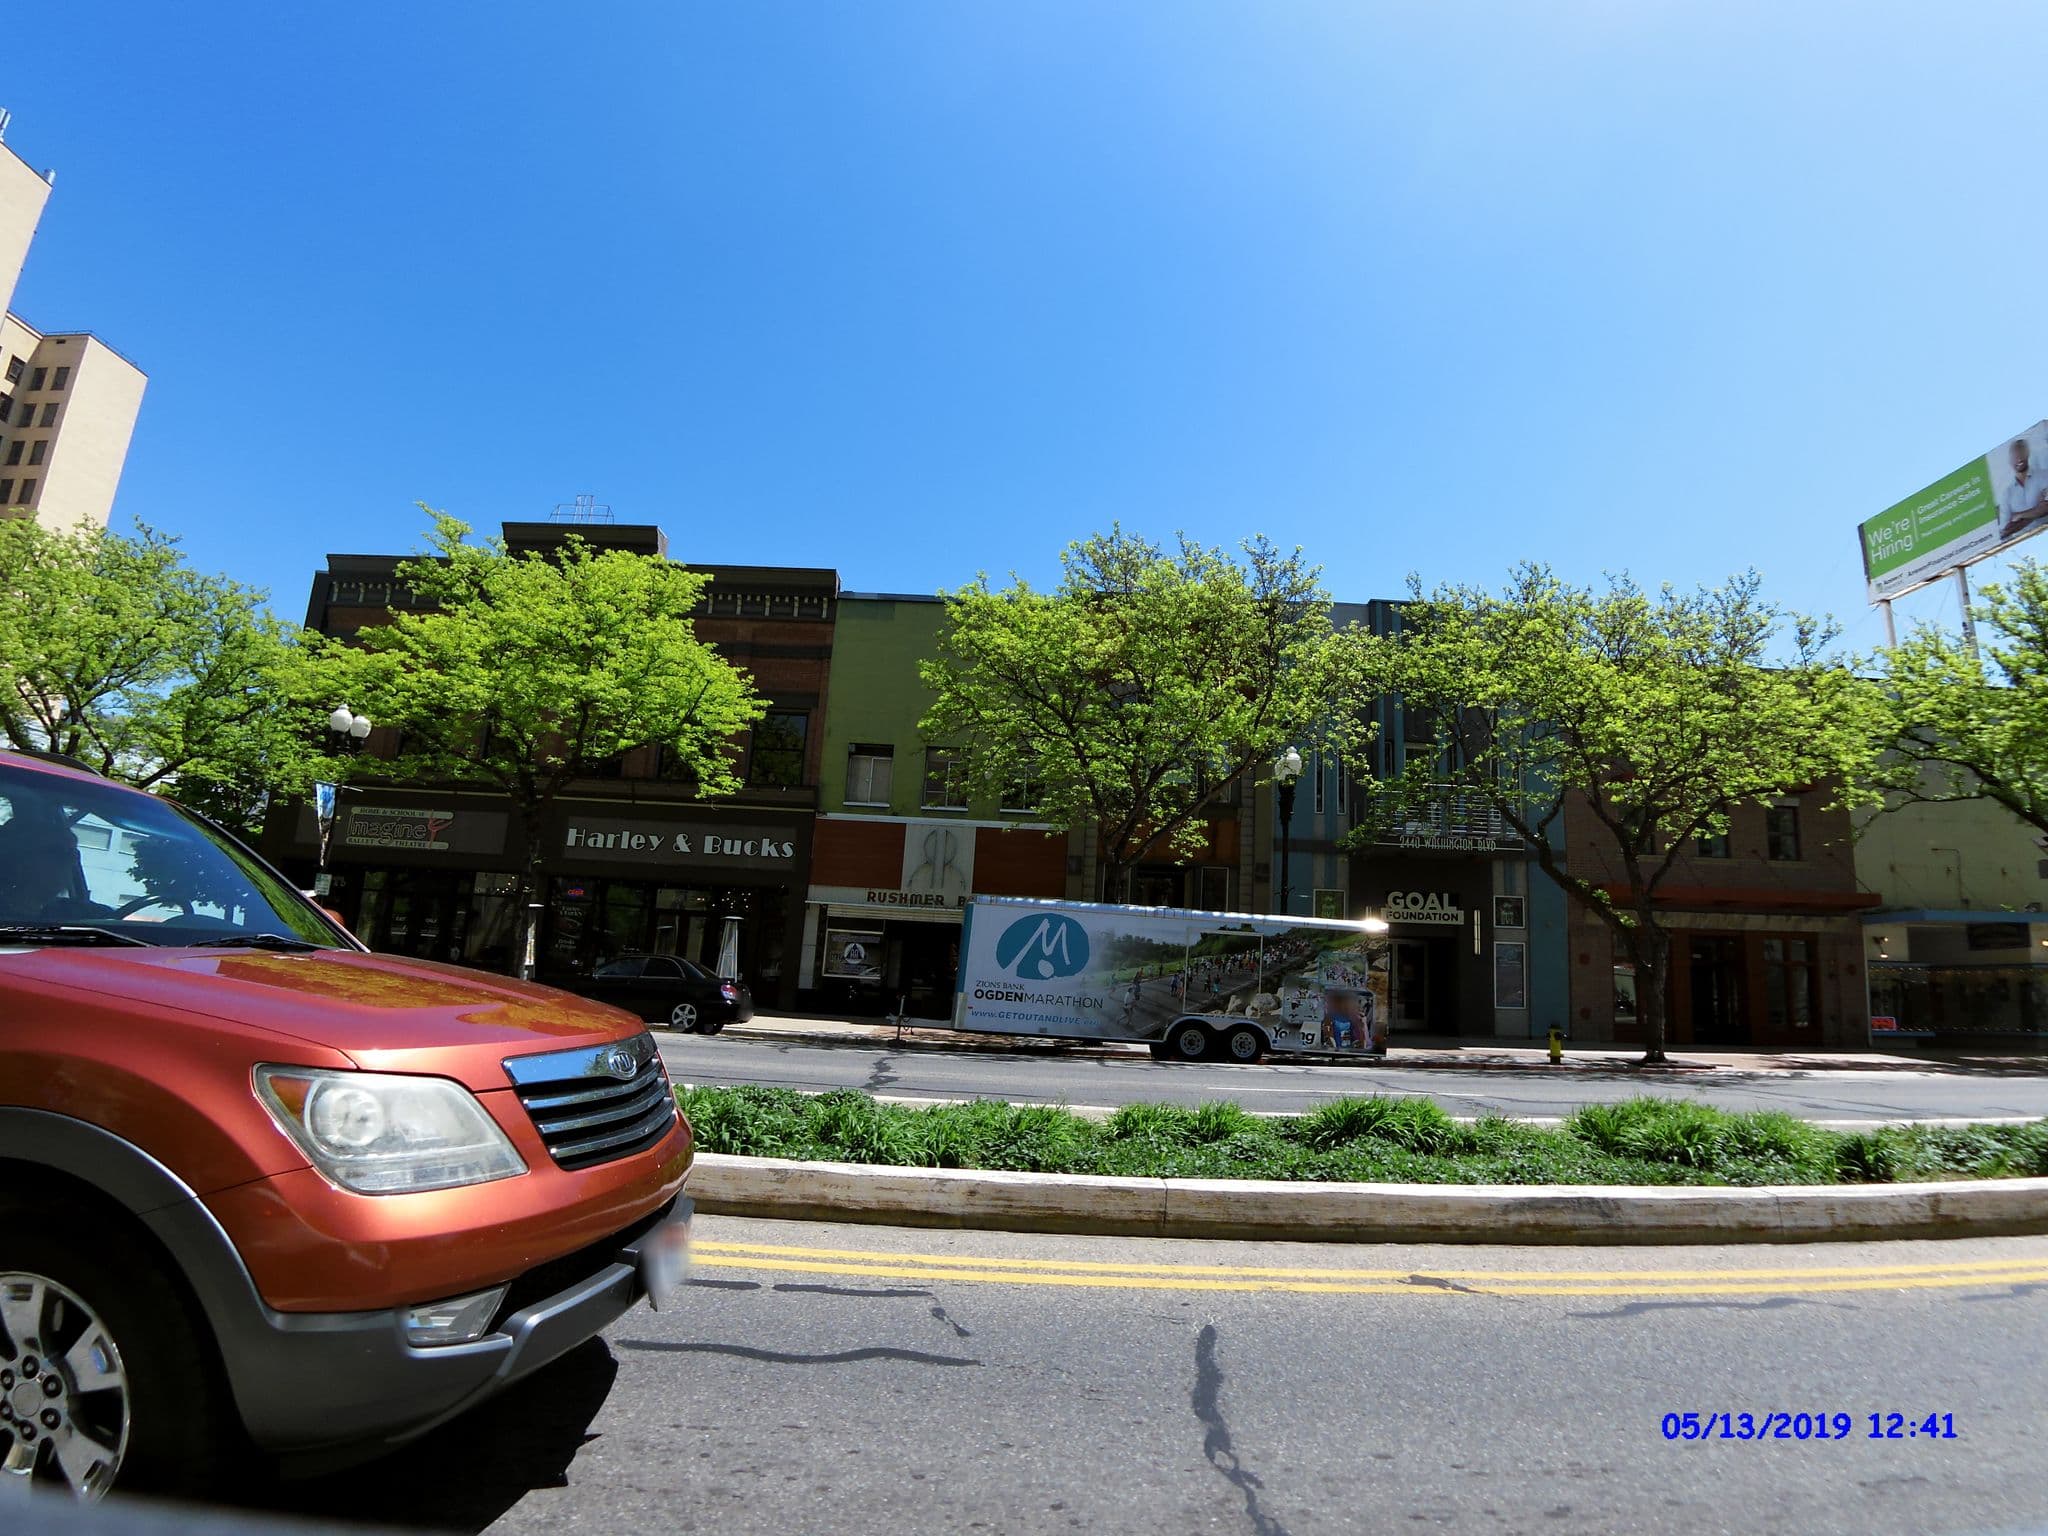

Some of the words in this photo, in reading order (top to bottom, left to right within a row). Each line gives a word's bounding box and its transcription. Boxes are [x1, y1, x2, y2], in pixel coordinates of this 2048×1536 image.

[1867, 516, 1910, 547] We're
[1870, 533, 1914, 564] Hiring
[566, 828, 665, 851] Harley
[672, 833, 692, 853] &
[703, 835, 795, 858] Bucks
[1400, 835, 1420, 849] 2440
[1424, 836, 1473, 851] WASHINGTON
[1477, 839, 1497, 852] BLVD
[867, 891, 945, 906] RUSHMER
[1387, 891, 1458, 911] GOAL
[1386, 910, 1459, 922] FOUNDATION
[975, 979, 1001, 989] ZIONS
[1002, 981, 1025, 991] BANK
[1272, 1026, 1316, 1045] Yong
